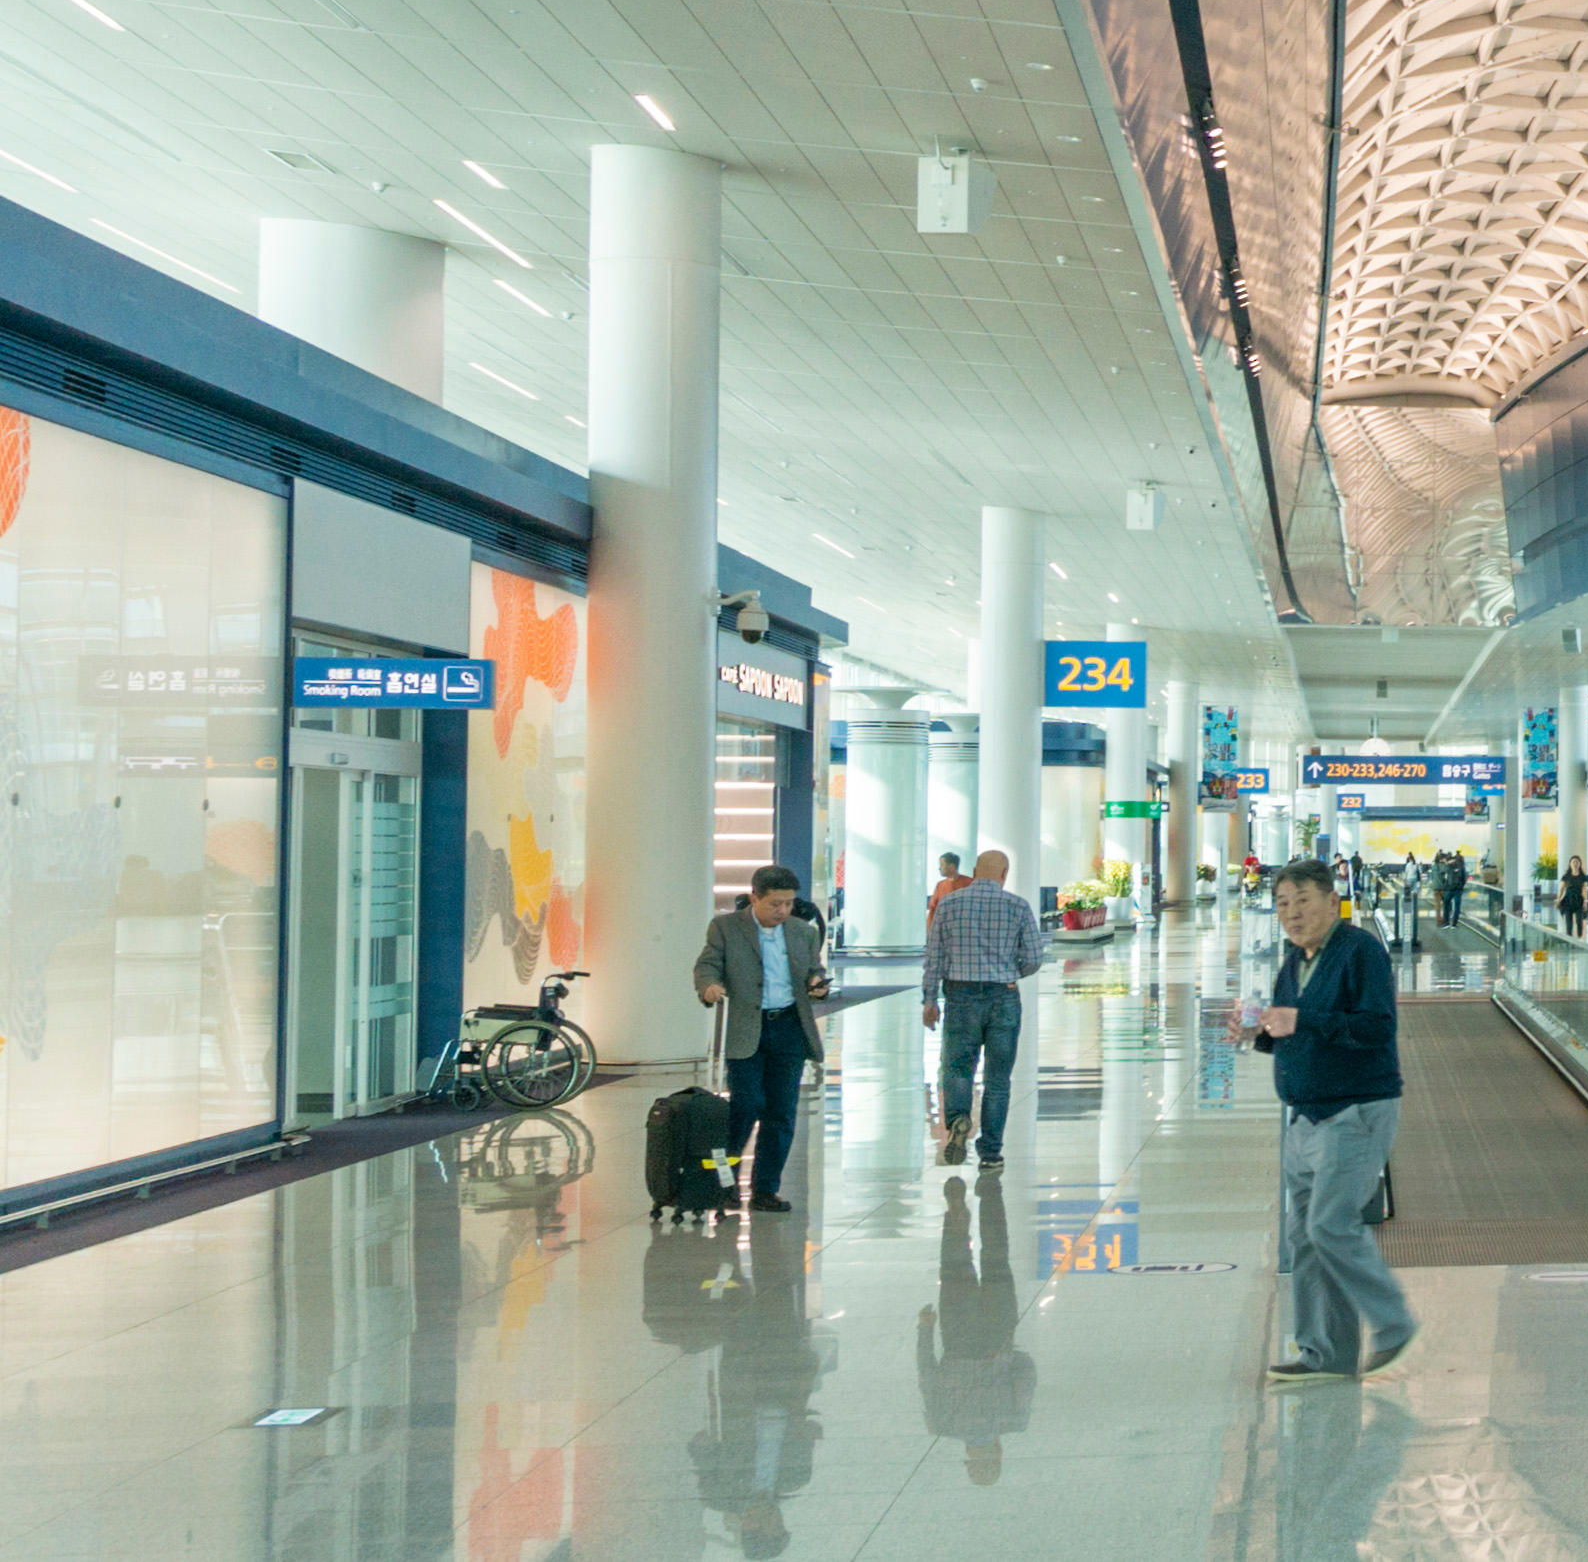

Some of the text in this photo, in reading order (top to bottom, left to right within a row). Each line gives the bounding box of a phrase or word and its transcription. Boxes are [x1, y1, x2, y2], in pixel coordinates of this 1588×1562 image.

[386, 671, 437, 694] 흡연실
[1058, 656, 1134, 692] 234
[303, 684, 382, 699] Smoking Room
[739, 663, 773, 699] SAPOON
[773, 673, 804, 706] SAPOON
[1326, 762, 1427, 780] 230-233,246-270
[1236, 773, 1266, 789] 233
[1341, 796, 1363, 809] 232
